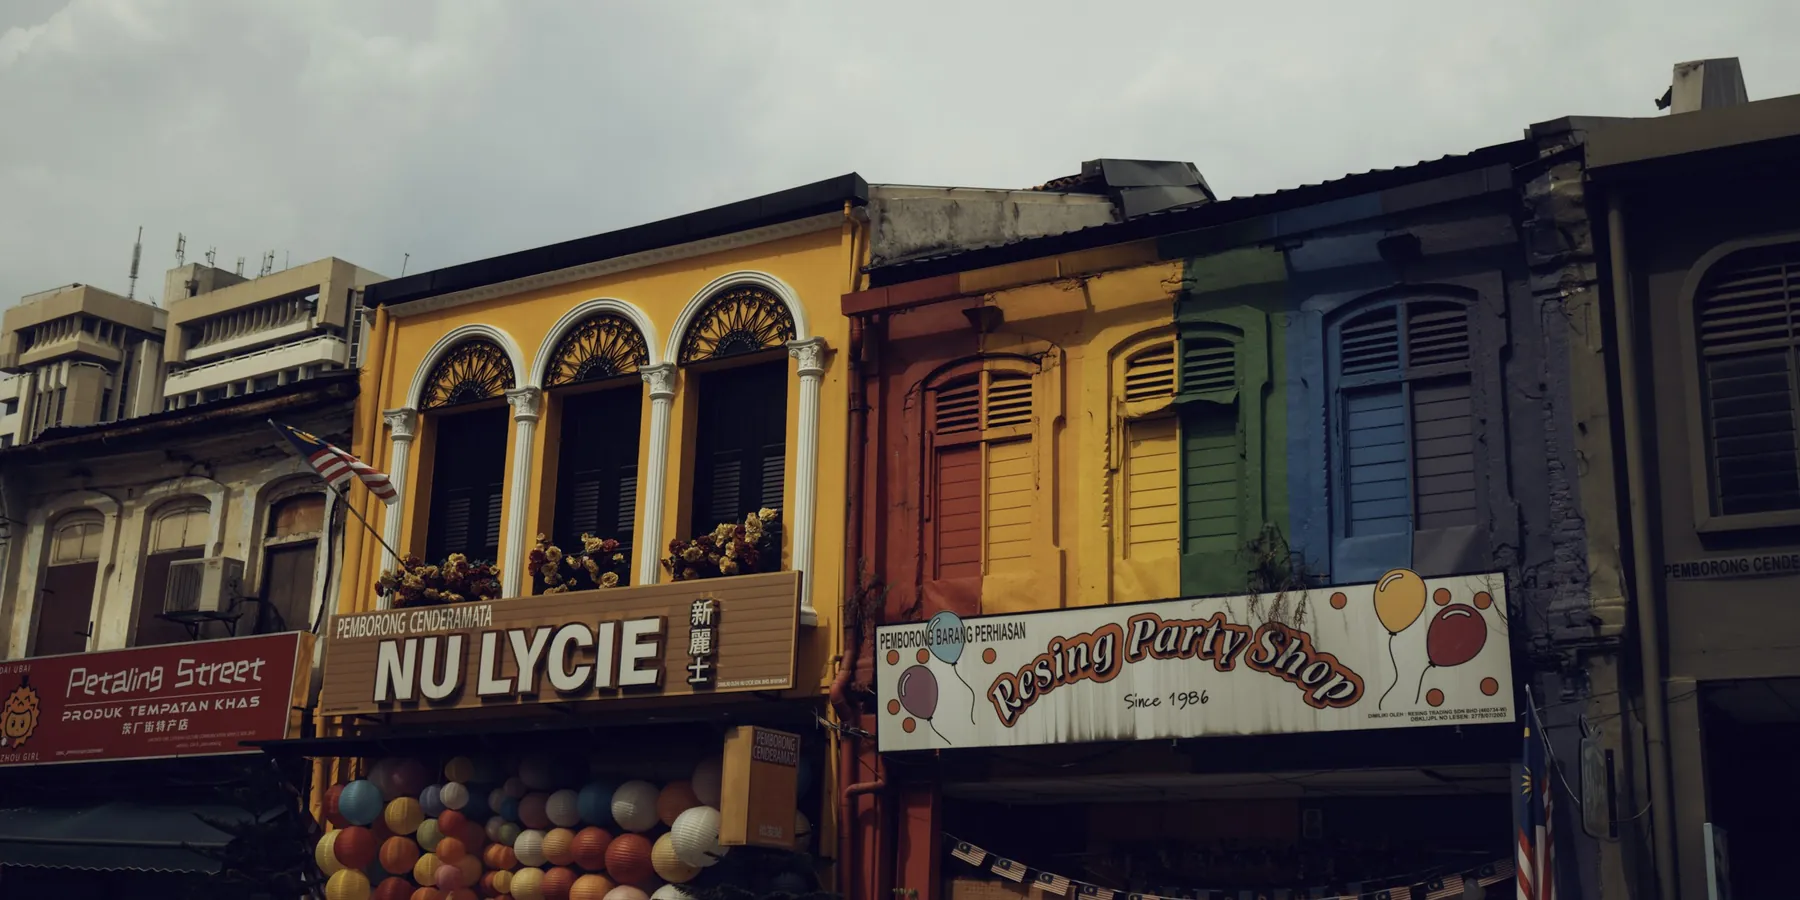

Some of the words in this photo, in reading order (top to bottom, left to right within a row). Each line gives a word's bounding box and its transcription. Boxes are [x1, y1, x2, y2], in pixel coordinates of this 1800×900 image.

[1664, 558, 1749, 579] PEMBORONG
[336, 612, 407, 640] PEMBORONG
[409, 604, 493, 633] CENDERAMATA
[880, 629, 934, 650] PEMBORONG
[936, 625, 973, 646] BARANG
[975, 621, 1026, 643] PERHIASAN
[686, 599, 714, 684] 新麗士
[373, 634, 464, 703] NU
[476, 617, 662, 697] LYCIE
[990, 630, 1117, 724] Resing
[1128, 618, 1248, 667] Party
[1249, 628, 1358, 704] Shop
[66, 666, 163, 698] Petaling
[174, 657, 266, 689] Street
[61, 706, 123, 722] PRODUK
[129, 700, 209, 717] TEMPATAN
[214, 695, 260, 711] KHAS
[1123, 692, 1162, 710] Since
[1168, 689, 1210, 710] 1986
[121, 718, 189, 735] 茨厂街特产店
[752, 745, 796, 764] CENDERAMATA
[756, 731, 796, 752] PEMBORONG
[22, 751, 40, 761] GIRL
